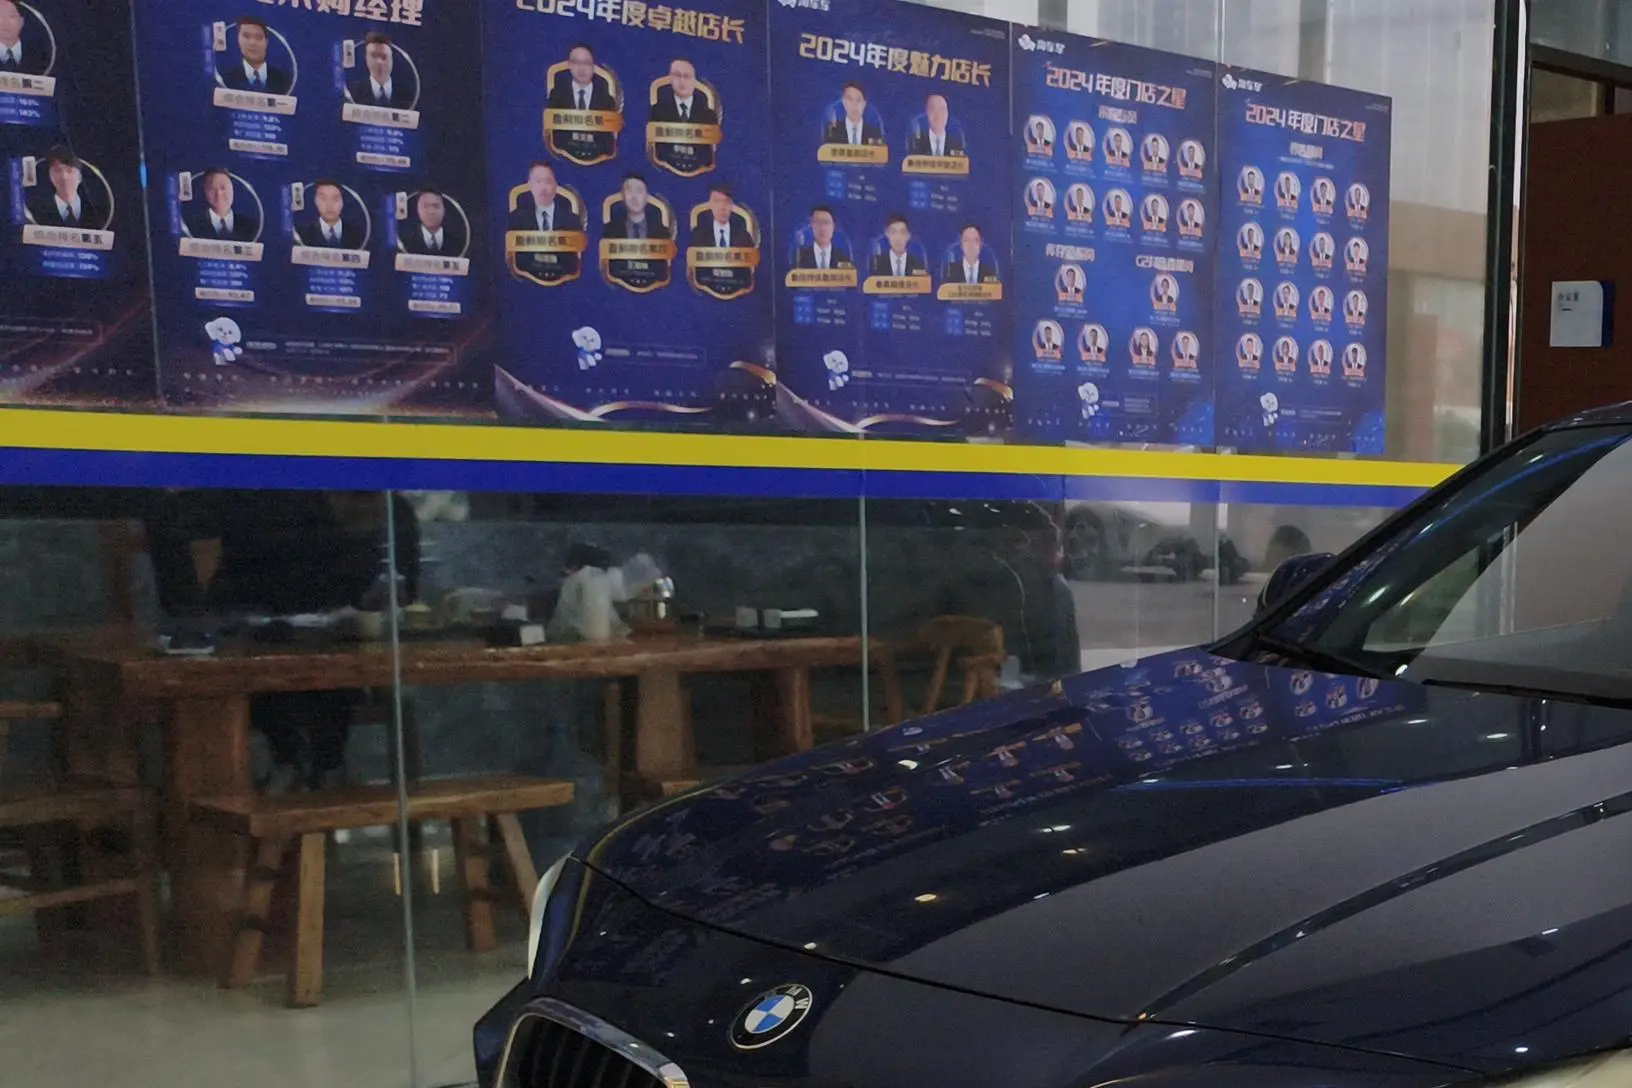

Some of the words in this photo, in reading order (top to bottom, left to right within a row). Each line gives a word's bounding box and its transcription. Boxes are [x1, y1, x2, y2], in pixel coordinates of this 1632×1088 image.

[256, 0, 423, 26] 购经理
[799, 32, 992, 88] 2024年度魅力店长
